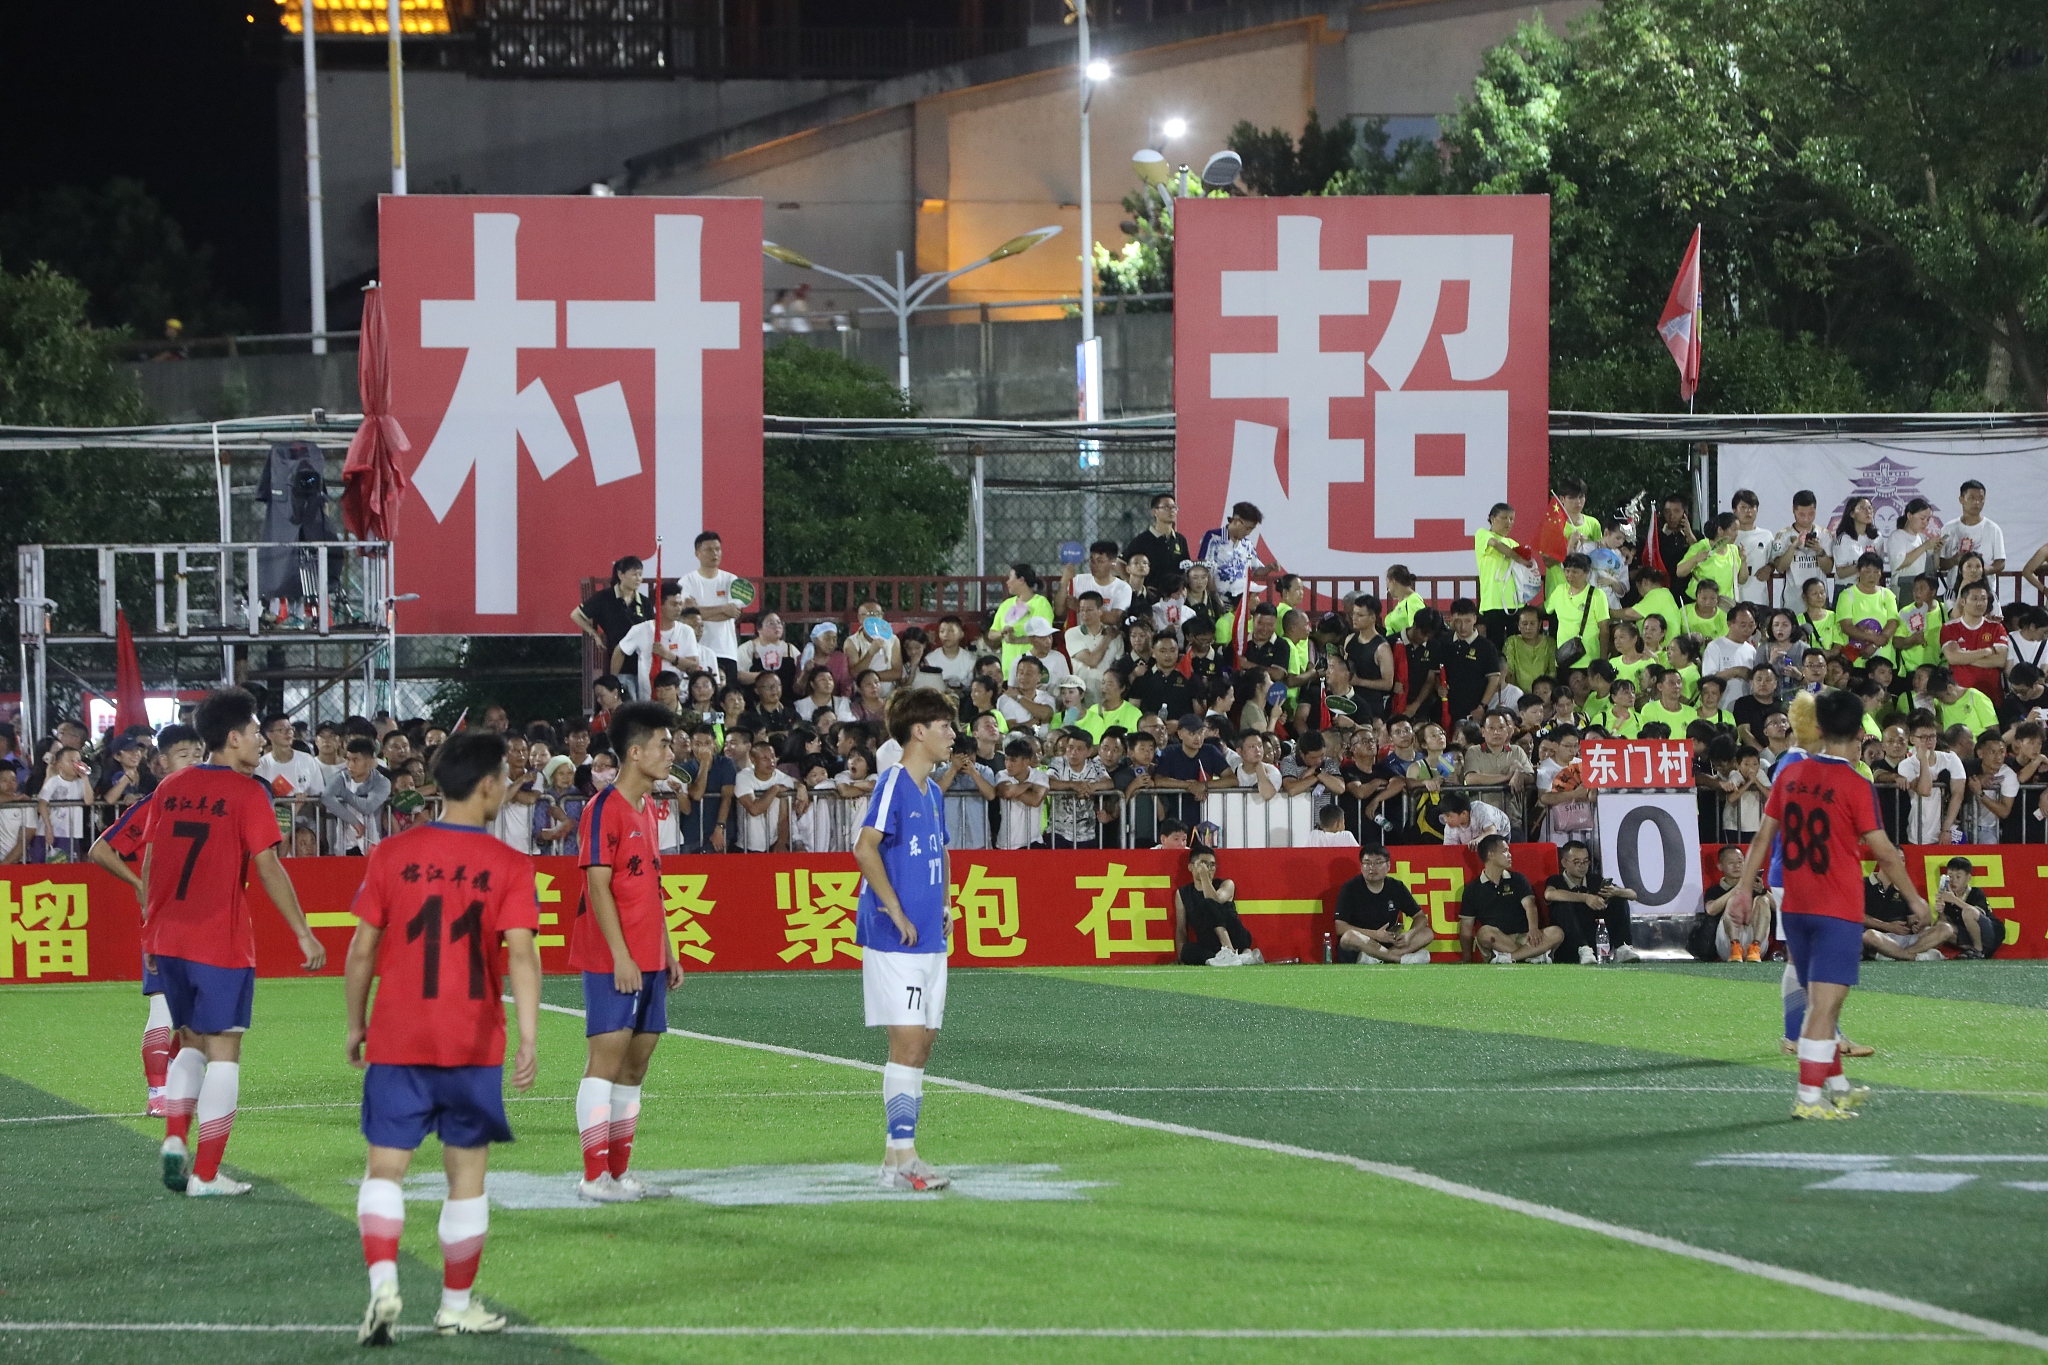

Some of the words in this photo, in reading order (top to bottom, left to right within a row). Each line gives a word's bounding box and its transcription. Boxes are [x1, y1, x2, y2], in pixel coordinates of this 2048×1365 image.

[412, 213, 742, 614] 村
[1210, 215, 1514, 600] 超
[1586, 742, 1690, 785] 东门村
[172, 820, 211, 901] 7
[1617, 805, 1687, 907] 0
[1782, 801, 1830, 875] 88
[406, 895, 487, 1000] 11
[906, 986, 922, 1010] 77
